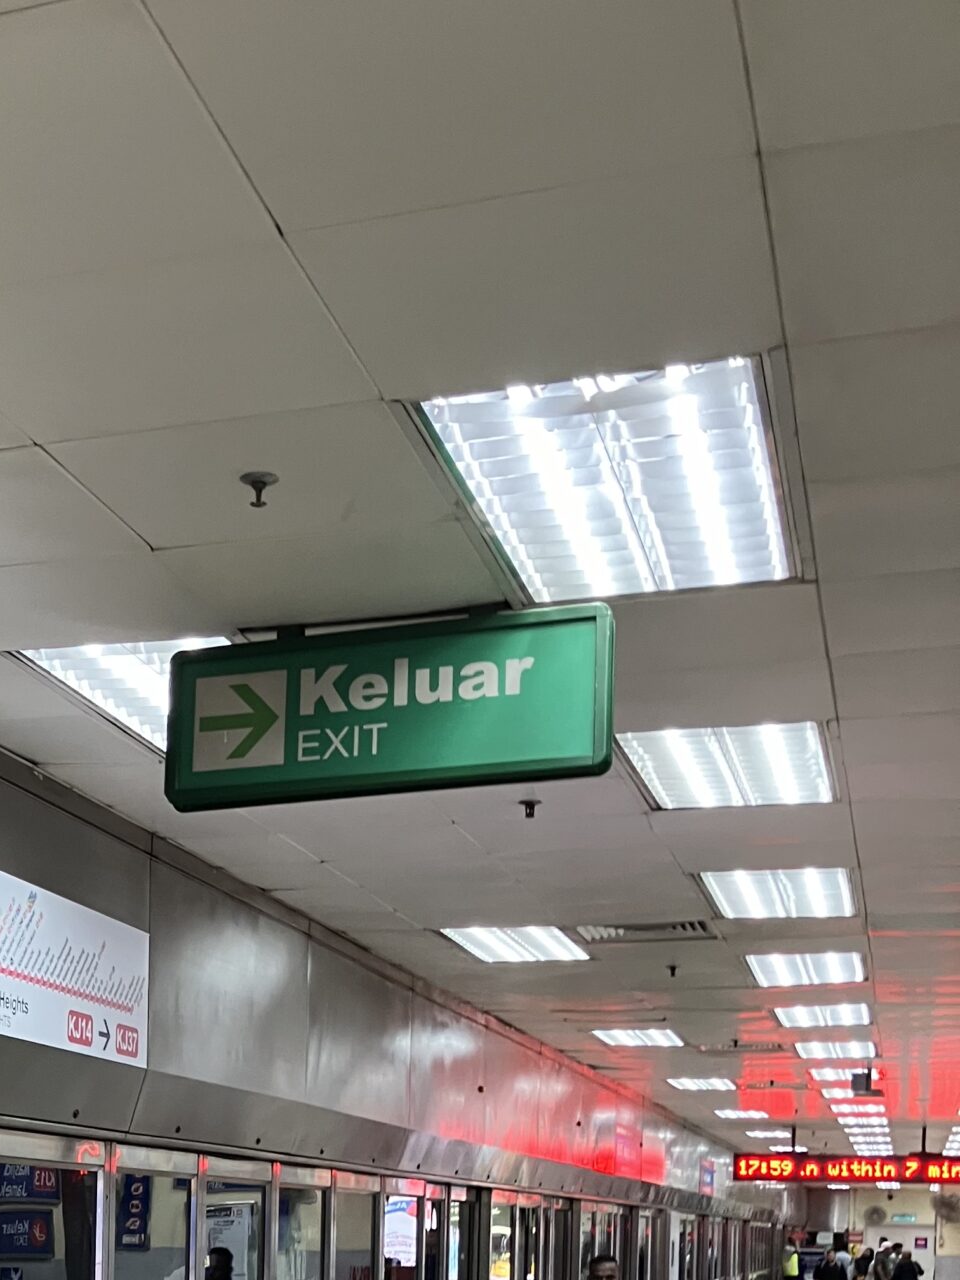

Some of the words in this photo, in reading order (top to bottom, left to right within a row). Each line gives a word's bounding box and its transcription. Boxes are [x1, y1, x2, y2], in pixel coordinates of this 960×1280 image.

[299, 656, 535, 716] Keluar
[297, 722, 388, 762] EXIT
[0, 990, 29, 1015] Heights
[68, 1014, 93, 1042] KJ14
[116, 1029, 138, 1053] KJ37
[738, 1159, 793, 1176] 17:59
[799, 1163, 818, 1177] n
[827, 1160, 896, 1177] within
[905, 1161, 918, 1177] 7
